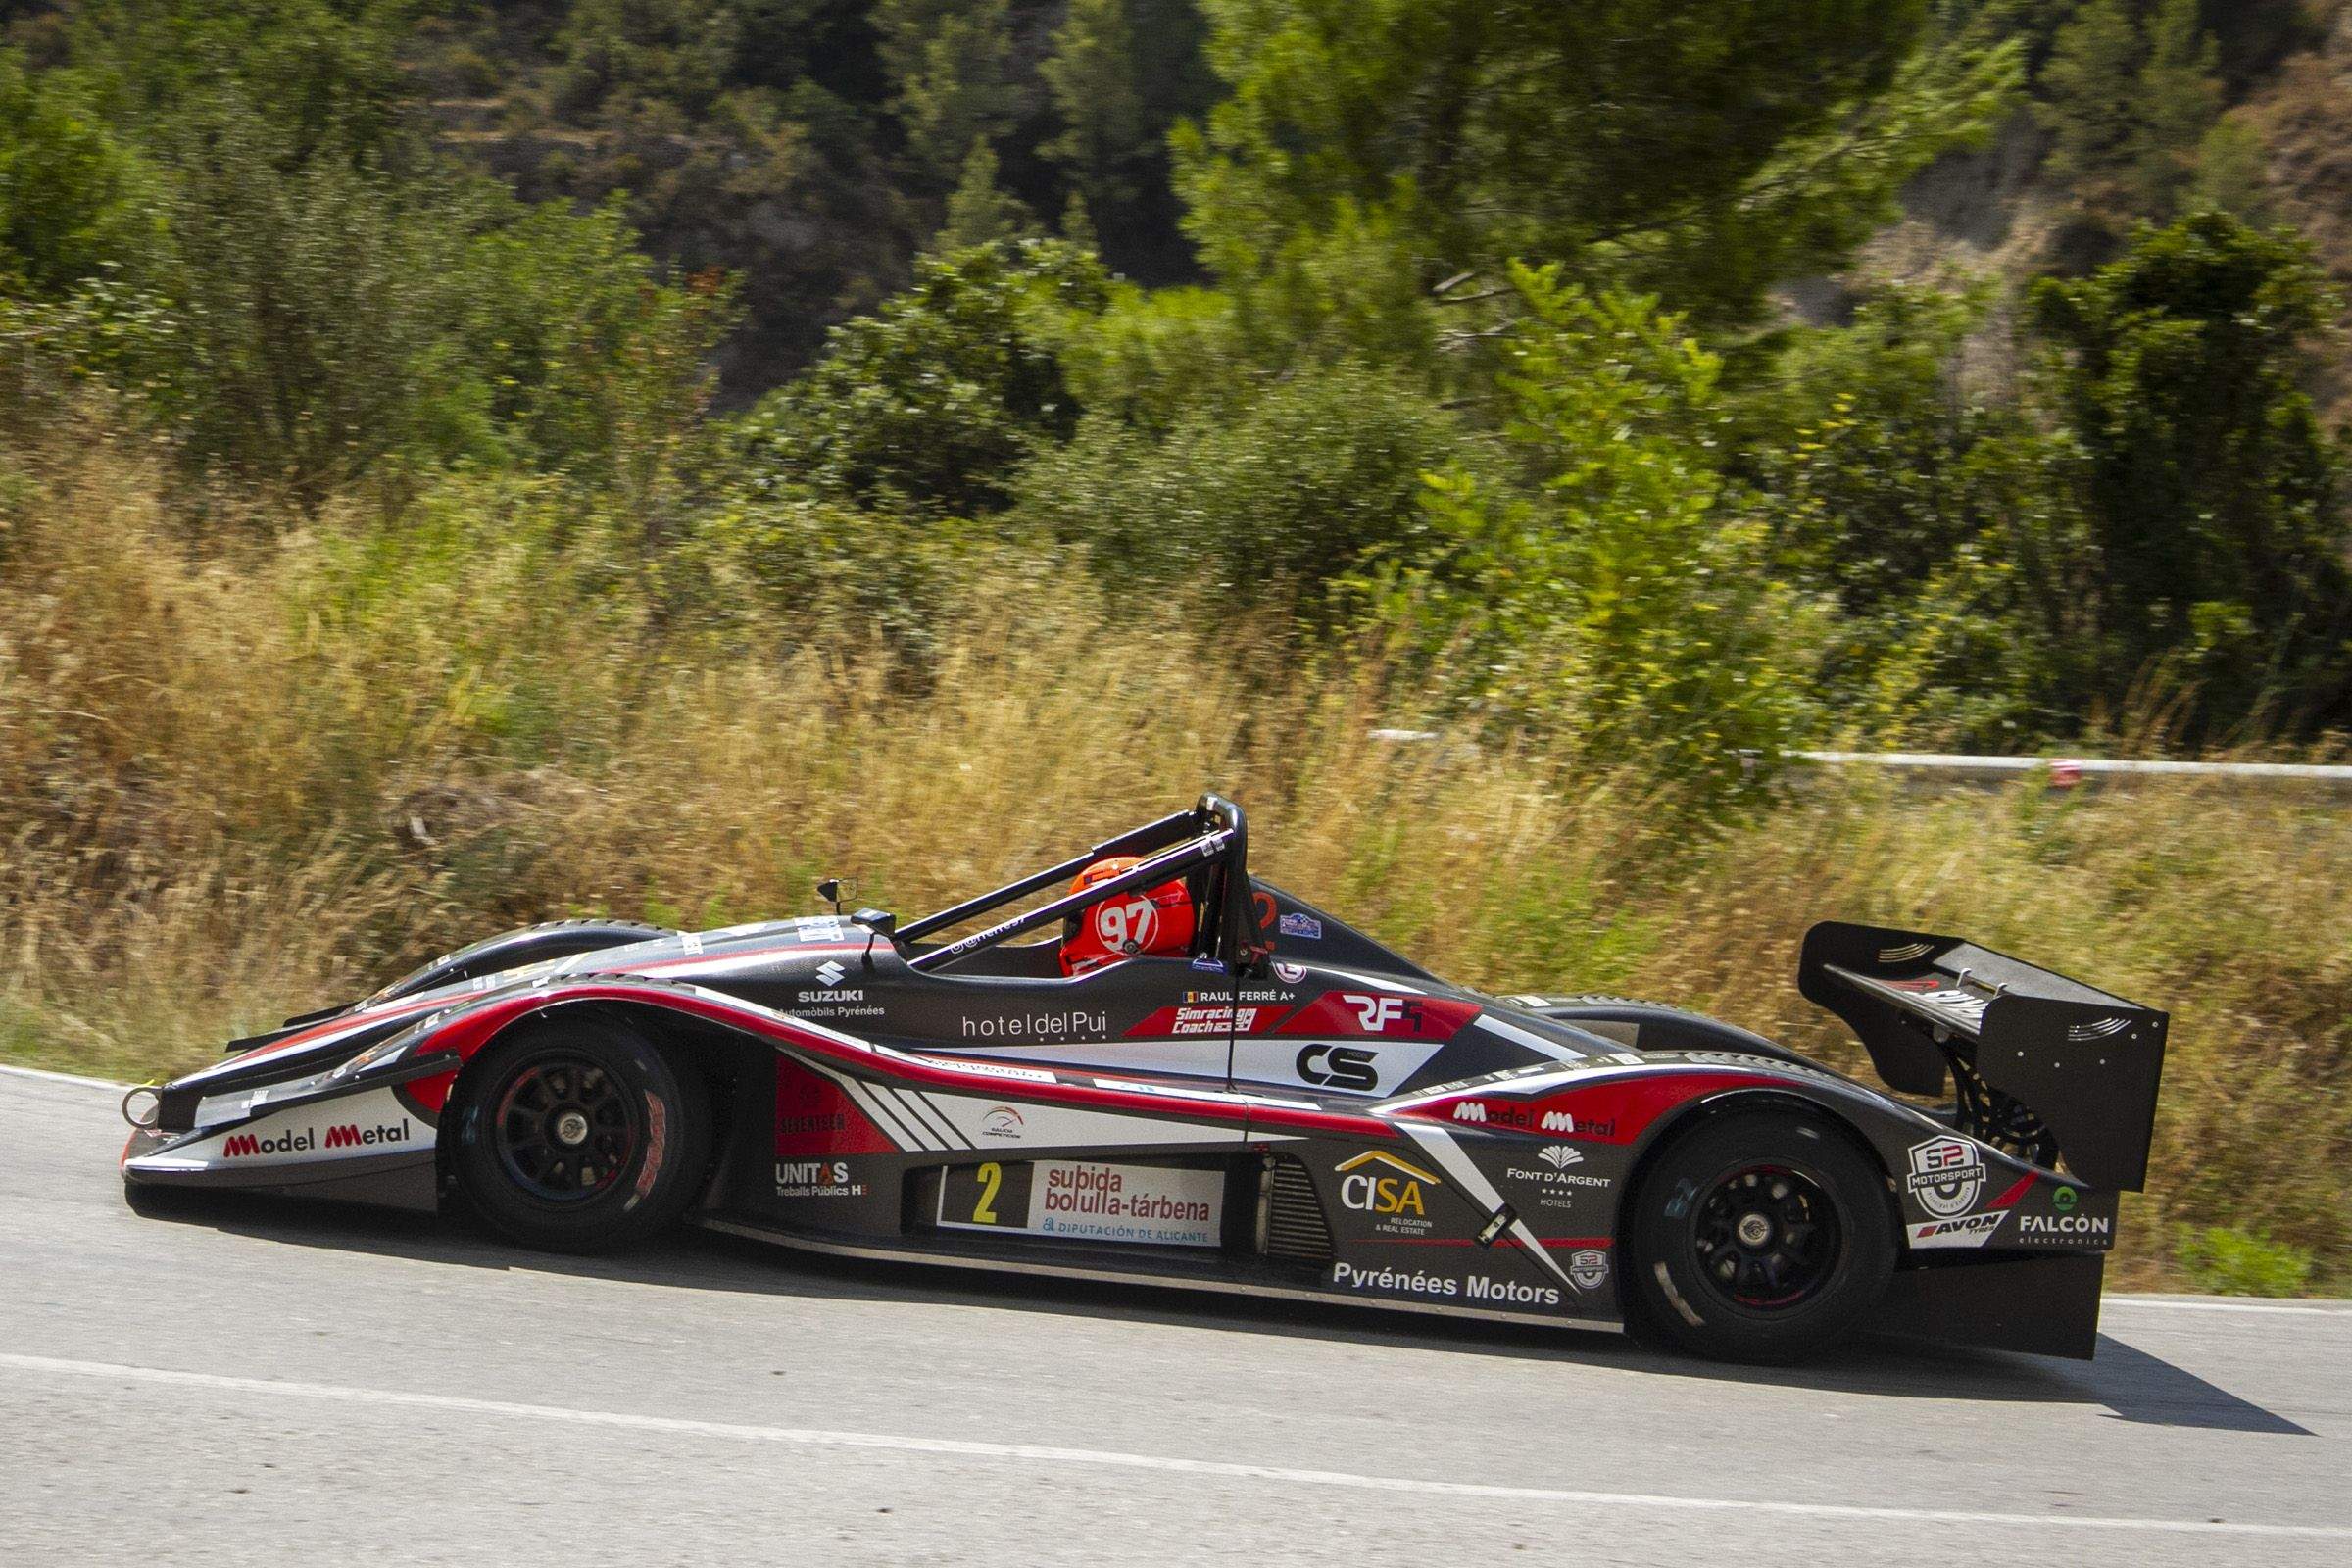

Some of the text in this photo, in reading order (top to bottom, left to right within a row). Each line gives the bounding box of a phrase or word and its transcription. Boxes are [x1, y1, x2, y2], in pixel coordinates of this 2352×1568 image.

[1100, 900, 1153, 952] 97
[798, 990, 863, 1003] SUZUKI
[1200, 989, 1295, 1001] RAUL FERRÉ A+
[837, 1005, 885, 1018] Pyrénées
[1172, 1021, 1214, 1034] Coach
[1296, 1044, 1380, 1091] CS
[1453, 1102, 1615, 1137] Model Metal
[223, 1118, 410, 1158] Model Metal
[775, 1162, 849, 1185] UNITAS
[1048, 1165, 1122, 1192] subida
[1506, 1168, 1543, 1181] FONT
[1912, 1168, 1981, 1186] MOTORSPORT
[776, 1186, 810, 1197] Treballs
[972, 1162, 1002, 1224] 2
[1341, 1174, 1426, 1215] CISA
[1045, 1187, 1209, 1222] bolulla-tárbena
[1540, 1199, 1572, 1208] HOTELS
[1057, 1221, 1208, 1243] DIPUTACIÓN DE ALICANTE
[1390, 1217, 1433, 1228] RELOCATION
[1400, 1226, 1425, 1235] ESTATE
[1936, 1214, 2000, 1235] AVON
[1333, 1262, 1559, 1304] Pyrénées Motors
